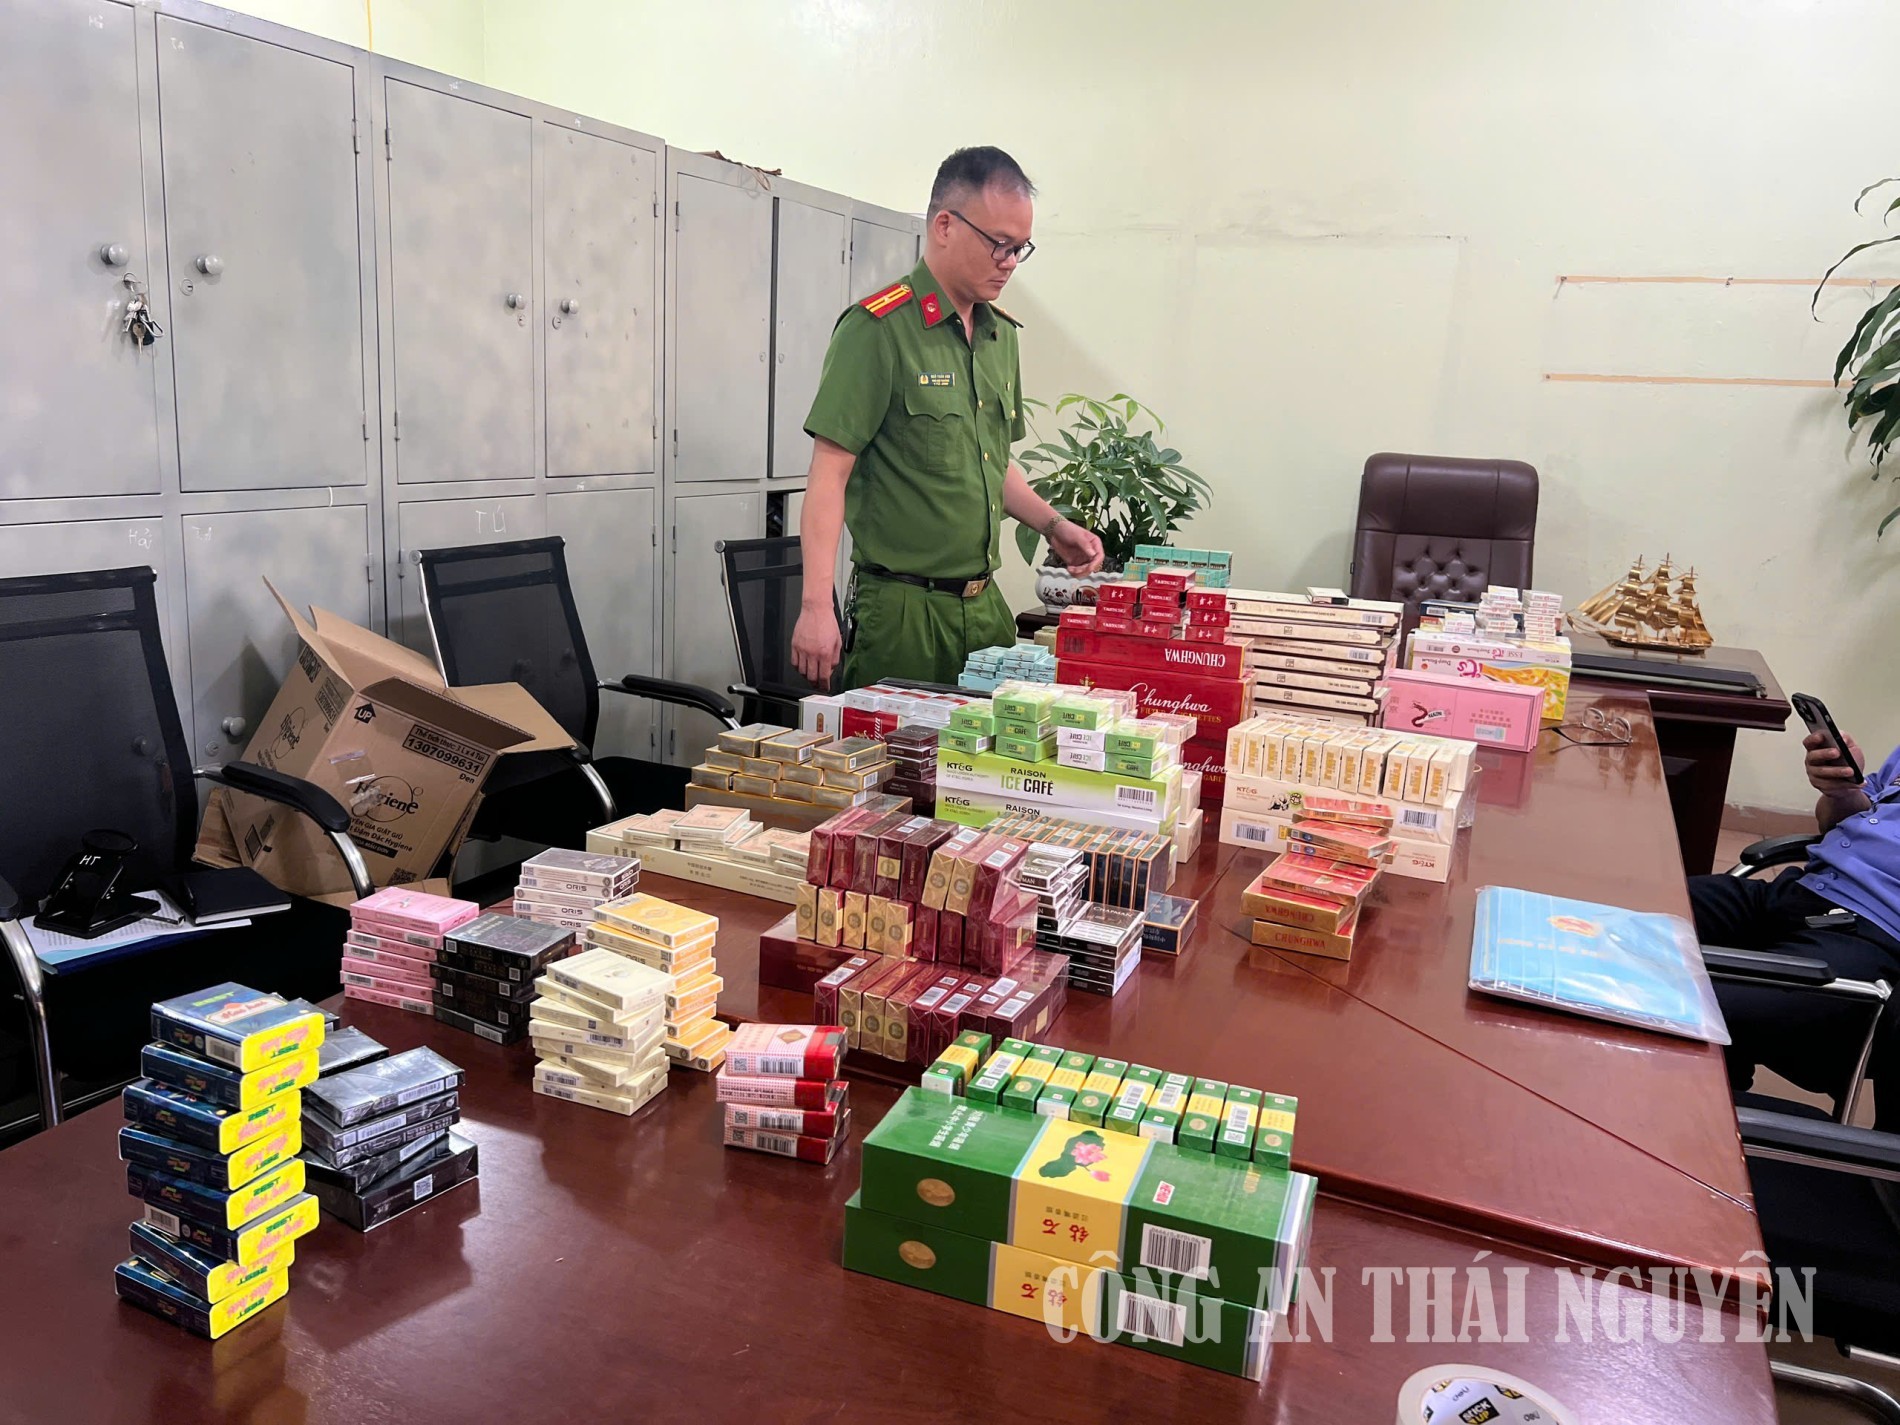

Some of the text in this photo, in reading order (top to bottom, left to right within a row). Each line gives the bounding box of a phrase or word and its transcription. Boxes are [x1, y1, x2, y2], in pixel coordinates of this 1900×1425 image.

[1164, 648, 1226, 668] CHUNGHWA
[357, 708, 373, 721] UP
[408, 737, 480, 774] 1307099631
[946, 761, 973, 772] KT&G
[1010, 767, 1047, 778] RAISON
[1000, 774, 1054, 796] ICE CAFÉ
[944, 795, 970, 807] KT&G
[1005, 803, 1041, 816] RAISON
[566, 883, 587, 892] ORIS
[561, 907, 583, 916] ORIS
[1093, 905, 1133, 918] CHAPMAN
[1265, 905, 1315, 922] CHUNGHWA
[560, 920, 582, 929] ORIS
[631, 923, 650, 935] ORIS
[1274, 932, 1326, 949] CHUNGHWA
[1042, 1217, 1090, 1244] 钻石
